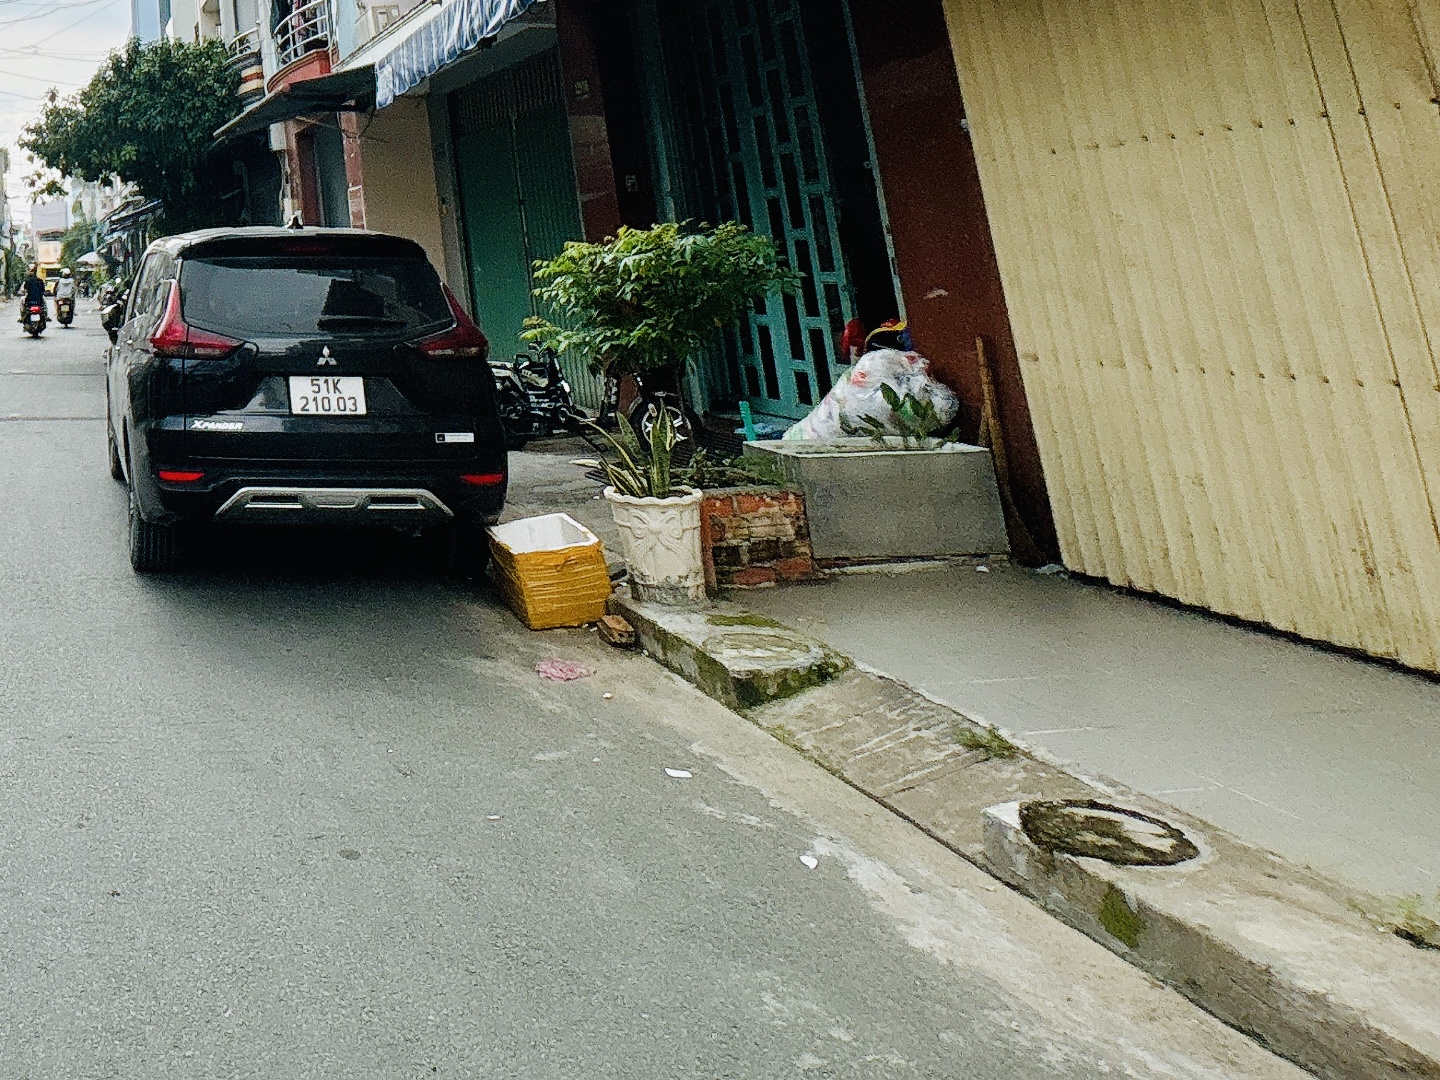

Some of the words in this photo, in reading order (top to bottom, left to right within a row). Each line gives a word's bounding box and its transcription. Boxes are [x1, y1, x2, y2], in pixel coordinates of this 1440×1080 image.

[310, 378, 342, 395] 51K
[299, 396, 358, 413] 210.03
[190, 419, 244, 430] XPANDER
